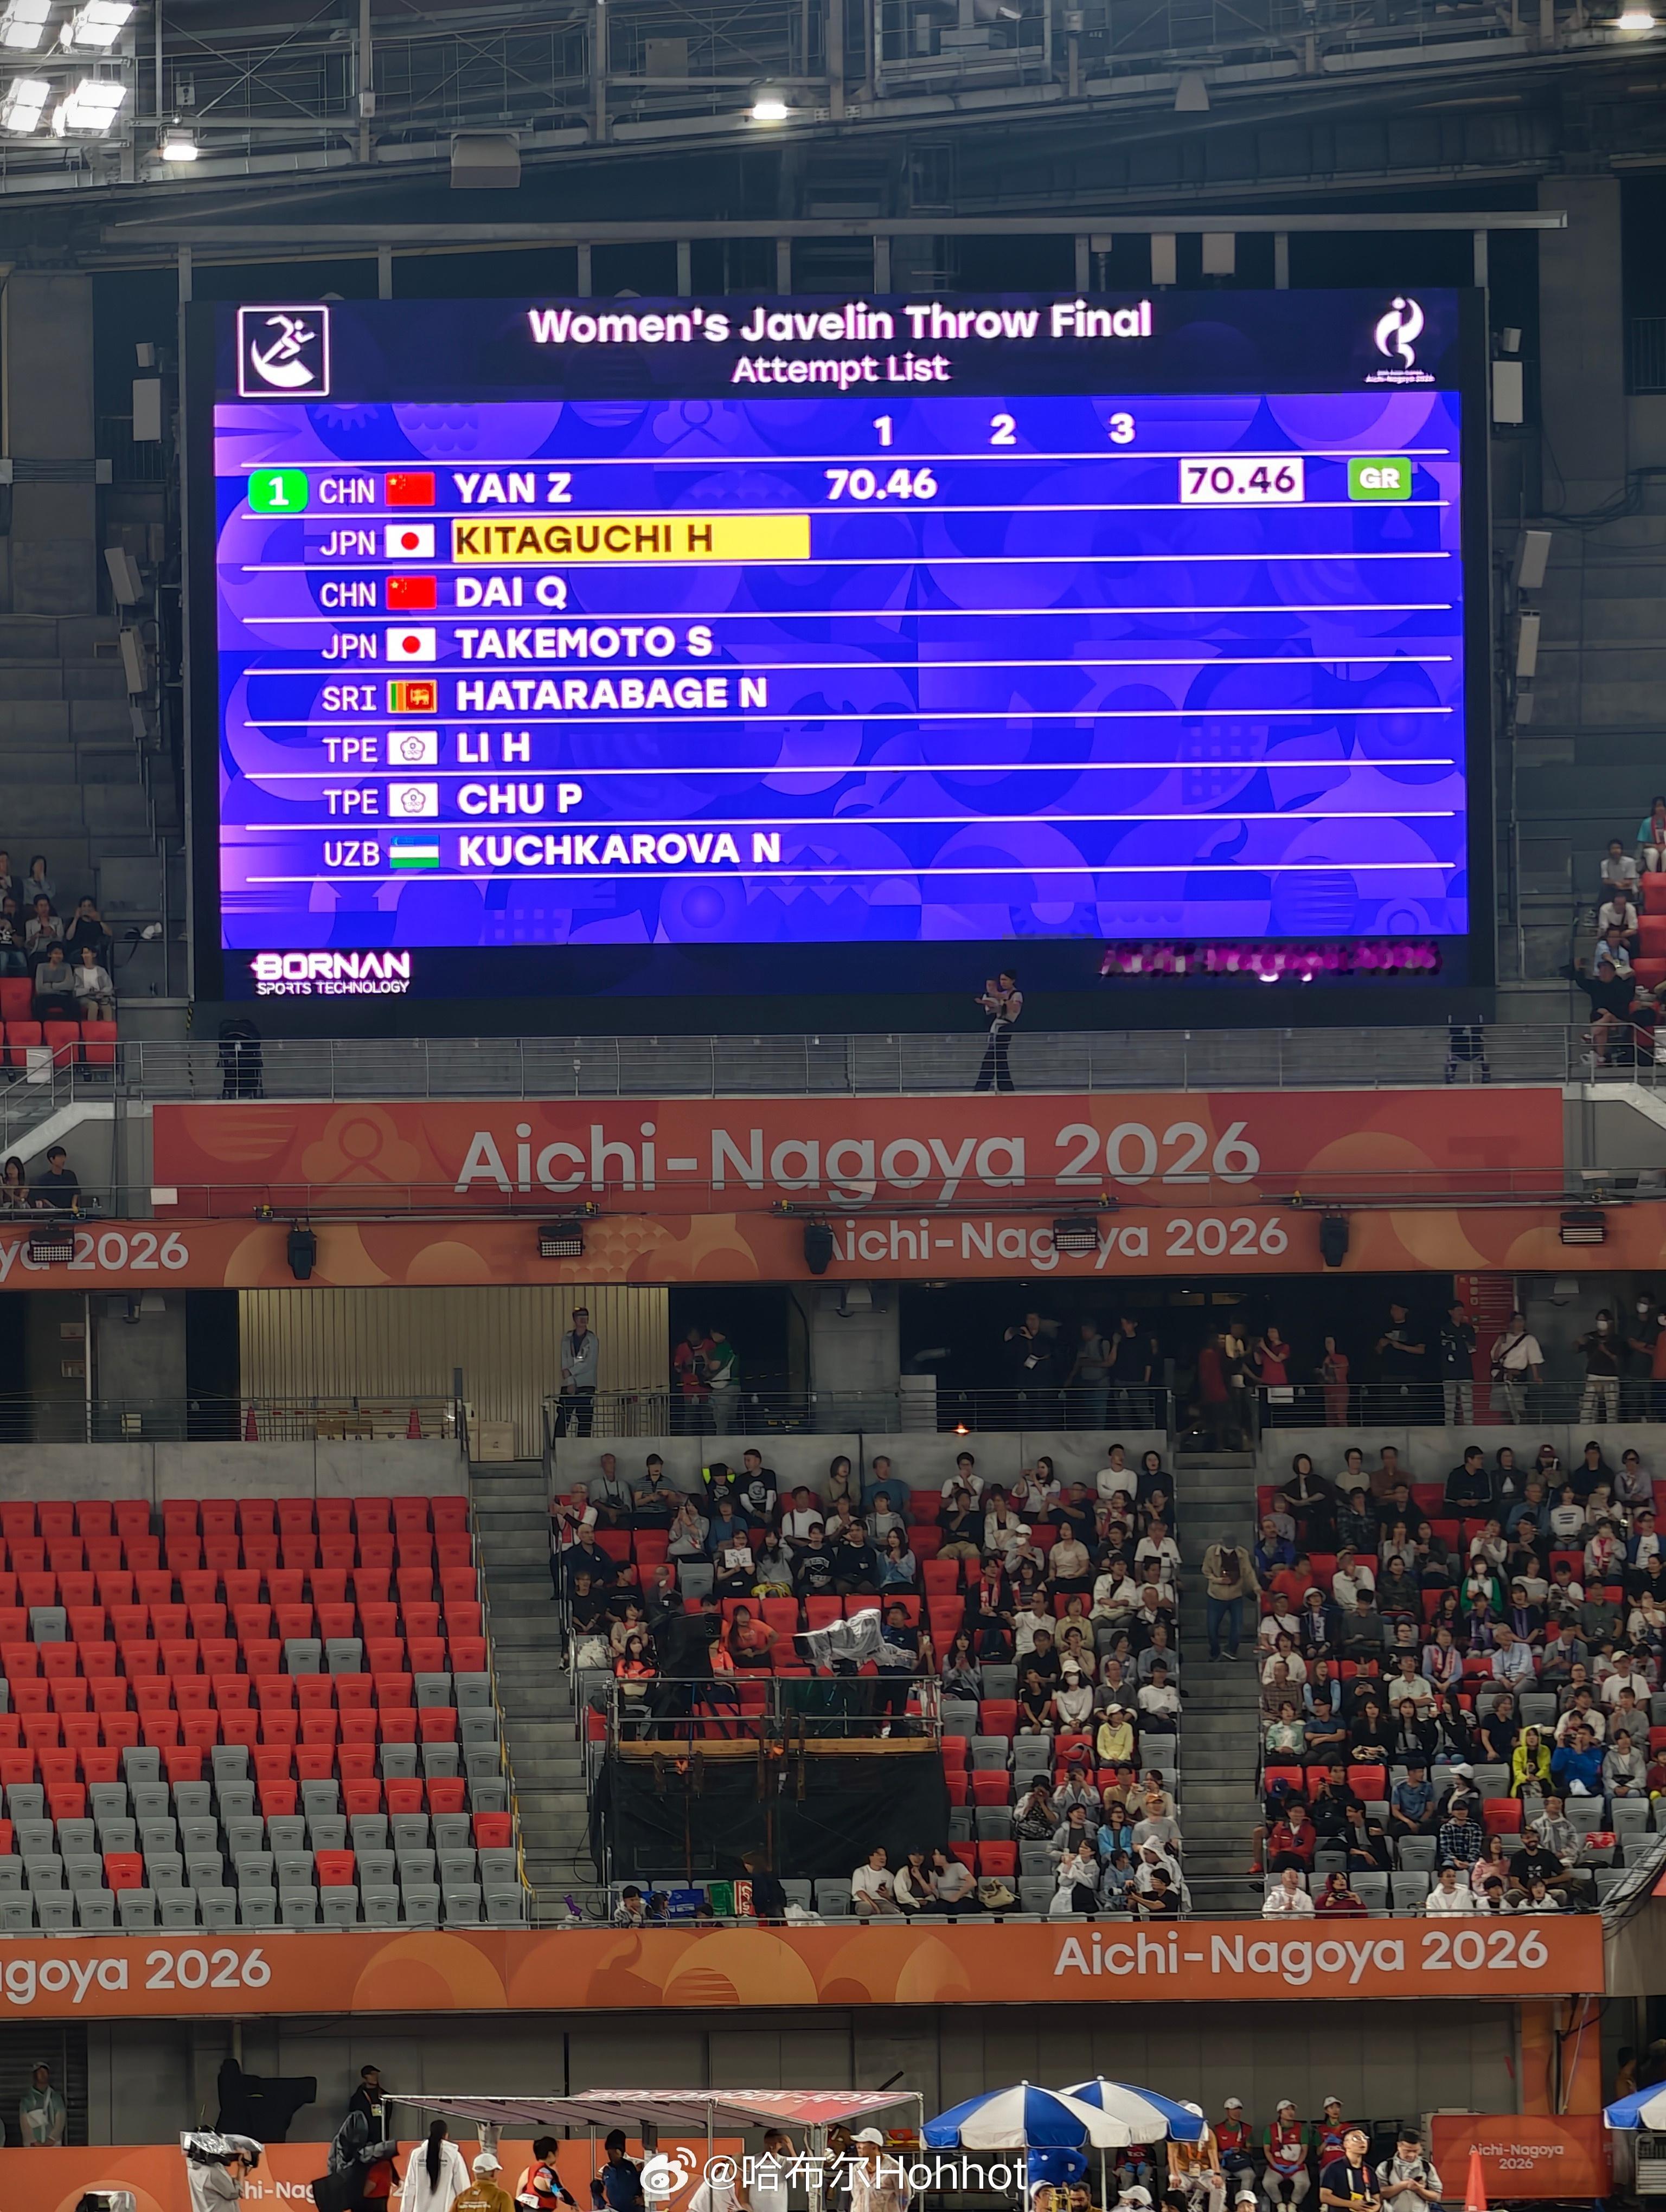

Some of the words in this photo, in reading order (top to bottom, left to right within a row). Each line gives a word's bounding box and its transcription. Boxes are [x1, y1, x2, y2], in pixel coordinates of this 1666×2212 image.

[528, 307, 729, 343] Women's
[740, 301, 893, 342] Javelin
[904, 302, 1039, 339] Throw
[1050, 299, 1151, 338] Final
[732, 356, 880, 390] Attempt
[888, 352, 950, 382] List
[875, 415, 891, 446] 1
[990, 414, 1016, 445] 2
[1110, 413, 1134, 444] 3
[269, 477, 289, 505] 1
[319, 478, 375, 504] CHN
[453, 473, 535, 504] YAN
[548, 472, 572, 503] Z
[826, 468, 937, 500] 70.46
[1189, 466, 1293, 493] 70.46
[1360, 467, 1400, 488] GR
[320, 530, 375, 556] JPN
[457, 525, 671, 554] KITAGUCHI
[688, 524, 712, 551] H
[321, 582, 376, 607] CHN
[456, 577, 522, 607] DAI
[536, 576, 567, 610] Q
[322, 634, 377, 659] JPN
[454, 626, 675, 659] TAKEMOTO
[687, 625, 713, 657] S
[322, 685, 377, 711] SRI
[457, 678, 728, 711] HATARABAGE
[740, 677, 767, 708] N
[322, 737, 378, 763] TPE
[458, 732, 489, 763] LI
[503, 732, 530, 762] H
[323, 789, 379, 814] TPE
[458, 783, 544, 815] CHU
[558, 783, 582, 813] P
[324, 841, 380, 866] UZB
[459, 833, 740, 866] KUCHKAROVA
[753, 832, 780, 863] N
[250, 951, 410, 980] BORNAN
[256, 982, 312, 995] SPORTS
[315, 980, 410, 994] TECHNOLOGY
[454, 1122, 1025, 1210] Aichi-Nagoya
[1055, 1121, 1260, 1186] 2026
[67, 1232, 189, 1270] 2026
[828, 1218, 1149, 1270] ichi-Nagya
[1165, 1218, 1288, 1257] 2026
[145, 1949, 271, 1990] 2026
[1054, 1931, 1405, 1985] Aichi-Nagoya
[1421, 1930, 1548, 1970] 2026
[1468, 2143, 1564, 2159] Aichi-Nagoya
[1498, 2158, 1534, 2170] 2026
